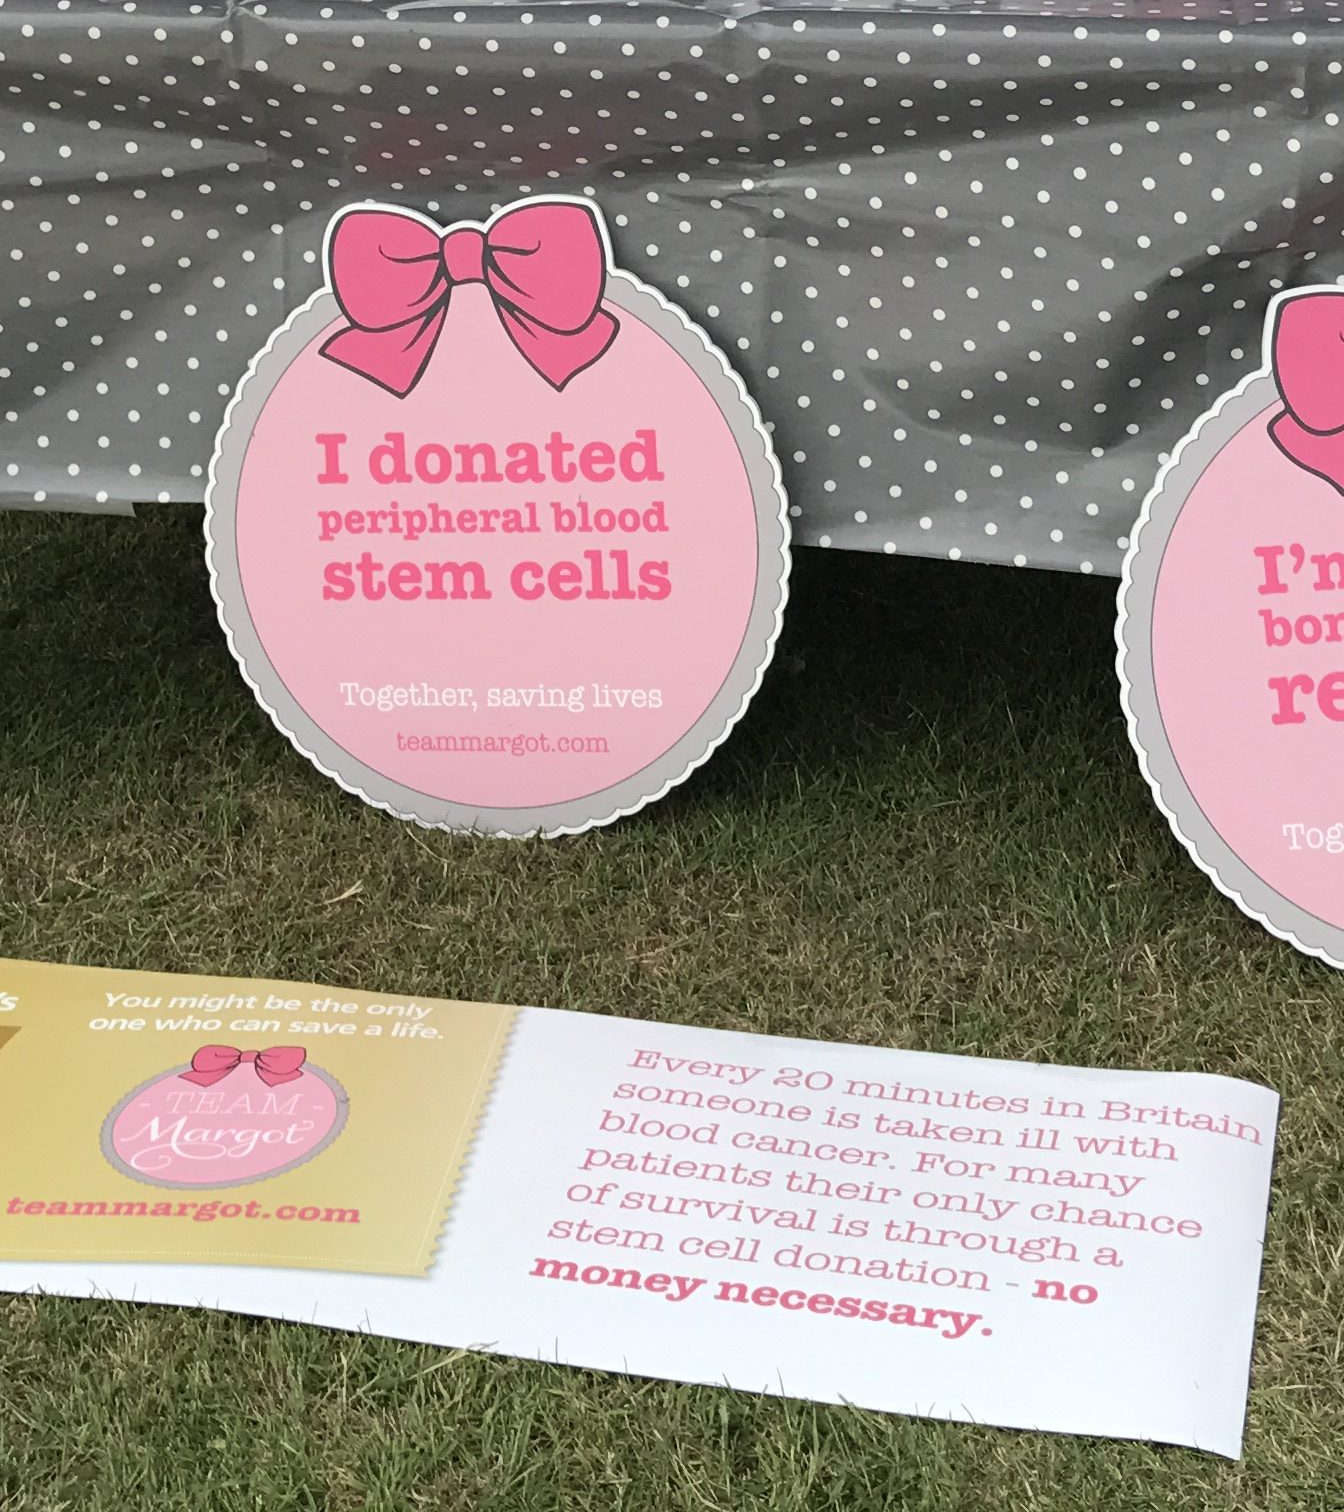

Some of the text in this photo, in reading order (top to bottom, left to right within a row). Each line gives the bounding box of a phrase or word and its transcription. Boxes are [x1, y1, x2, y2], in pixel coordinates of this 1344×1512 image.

[315, 429, 665, 484] I donated
[318, 501, 669, 541] peripheral blood
[323, 549, 672, 601] stem cells
[339, 682, 663, 713] Together, saving lives
[397, 732, 610, 757] teammargot.com
[105, 993, 433, 1020] You might be the only
[612, 1082, 1180, 1163] someone is taken ill with
[626, 1048, 1263, 1147] Every 20 minutes in Britain
[121, 1117, 314, 1171] Margot
[599, 1110, 1145, 1198] blood cancer. For many
[6, 1196, 361, 1224] teammargot.com
[578, 1146, 1204, 1241] patients their only chance
[566, 1179, 1124, 1269] of survival is through a
[547, 1216, 1099, 1308] stem cell donation no
[528, 1250, 994, 1342] money necessary.
